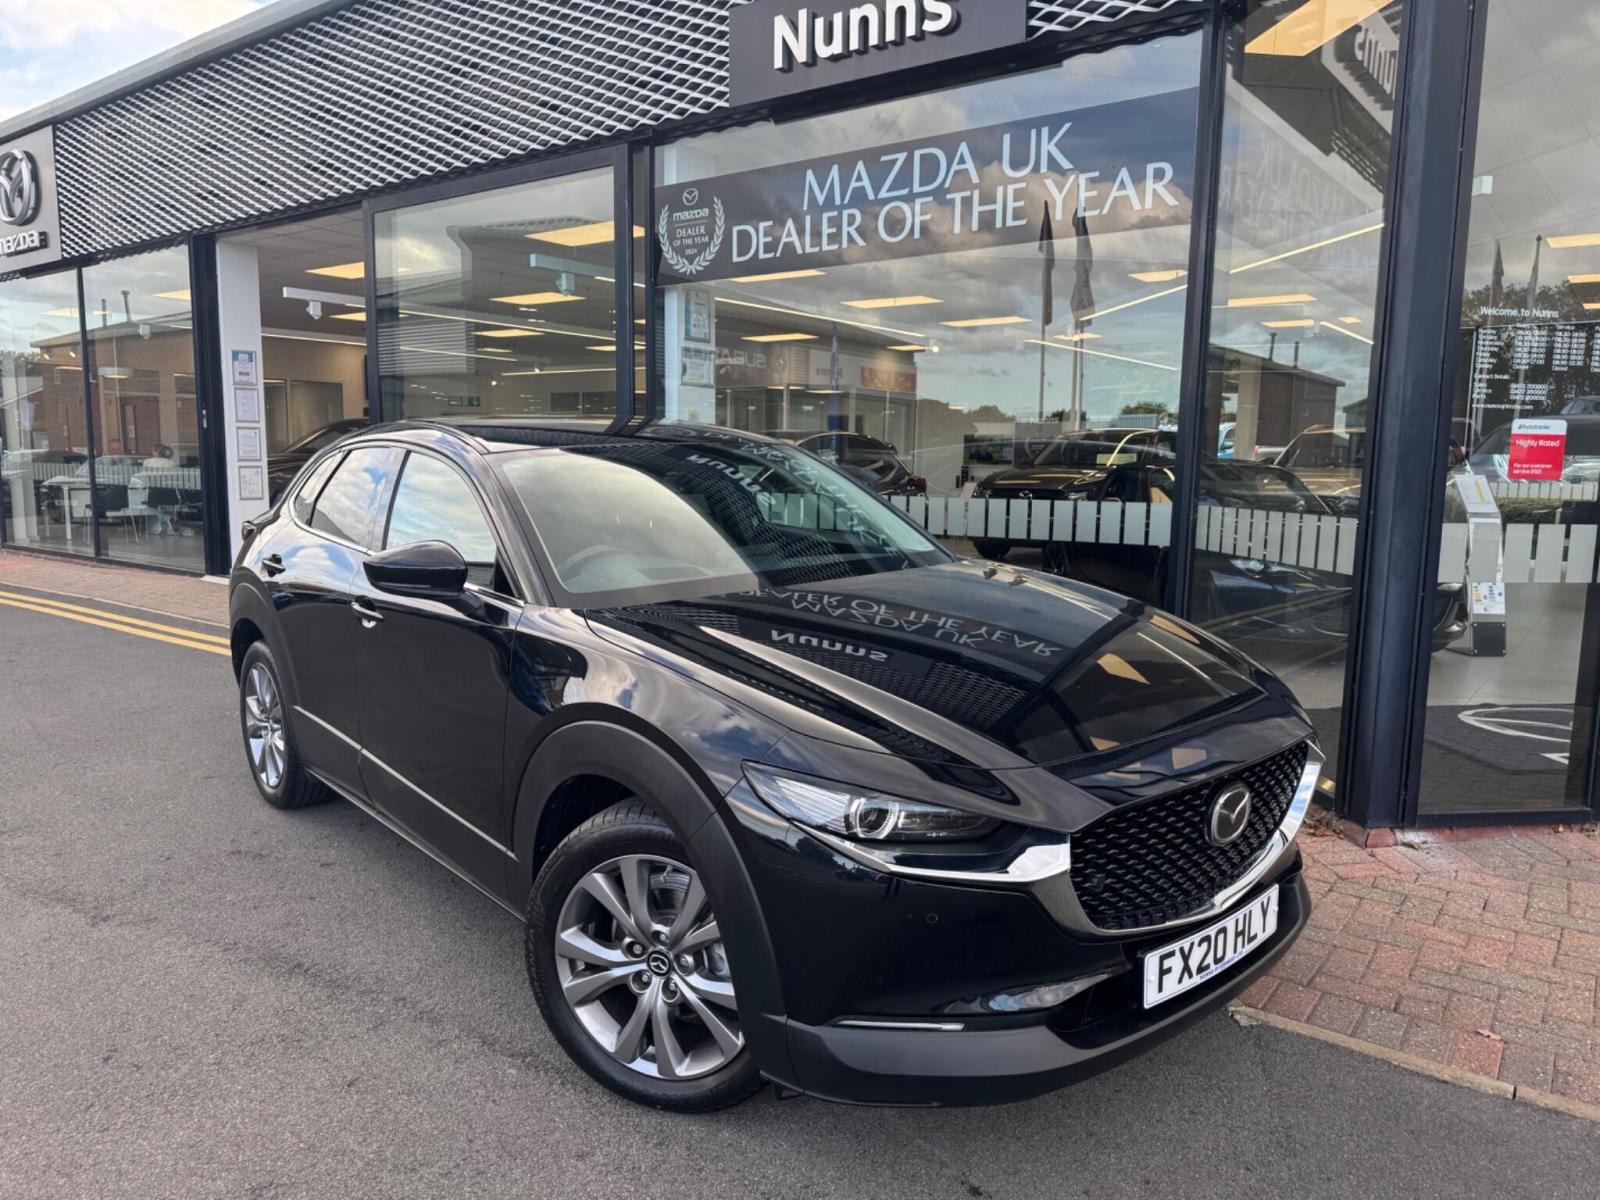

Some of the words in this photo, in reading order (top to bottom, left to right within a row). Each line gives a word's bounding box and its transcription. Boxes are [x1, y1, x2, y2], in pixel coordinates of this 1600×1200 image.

[774, 0, 953, 70] Nunns
[803, 141, 980, 210] MAZDA
[1002, 122, 1074, 178] UK
[732, 208, 867, 262] DEALER
[877, 196, 934, 243] OF
[946, 182, 1027, 234] THE
[1044, 161, 1179, 220] YEAR
[0, 230, 40, 255] azda
[672, 239, 681, 247] OF
[682, 237, 693, 246] THE
[694, 235, 710, 244] YEAR
[676, 225, 706, 238] DEALER
[1480, 306, 1518, 317] Welcome
[1521, 308, 1530, 317] to
[1532, 308, 1560, 318] Nunns
[1516, 439, 1538, 447] Highly
[1158, 926, 1228, 994] FX20
[1233, 896, 1271, 954] HLY
